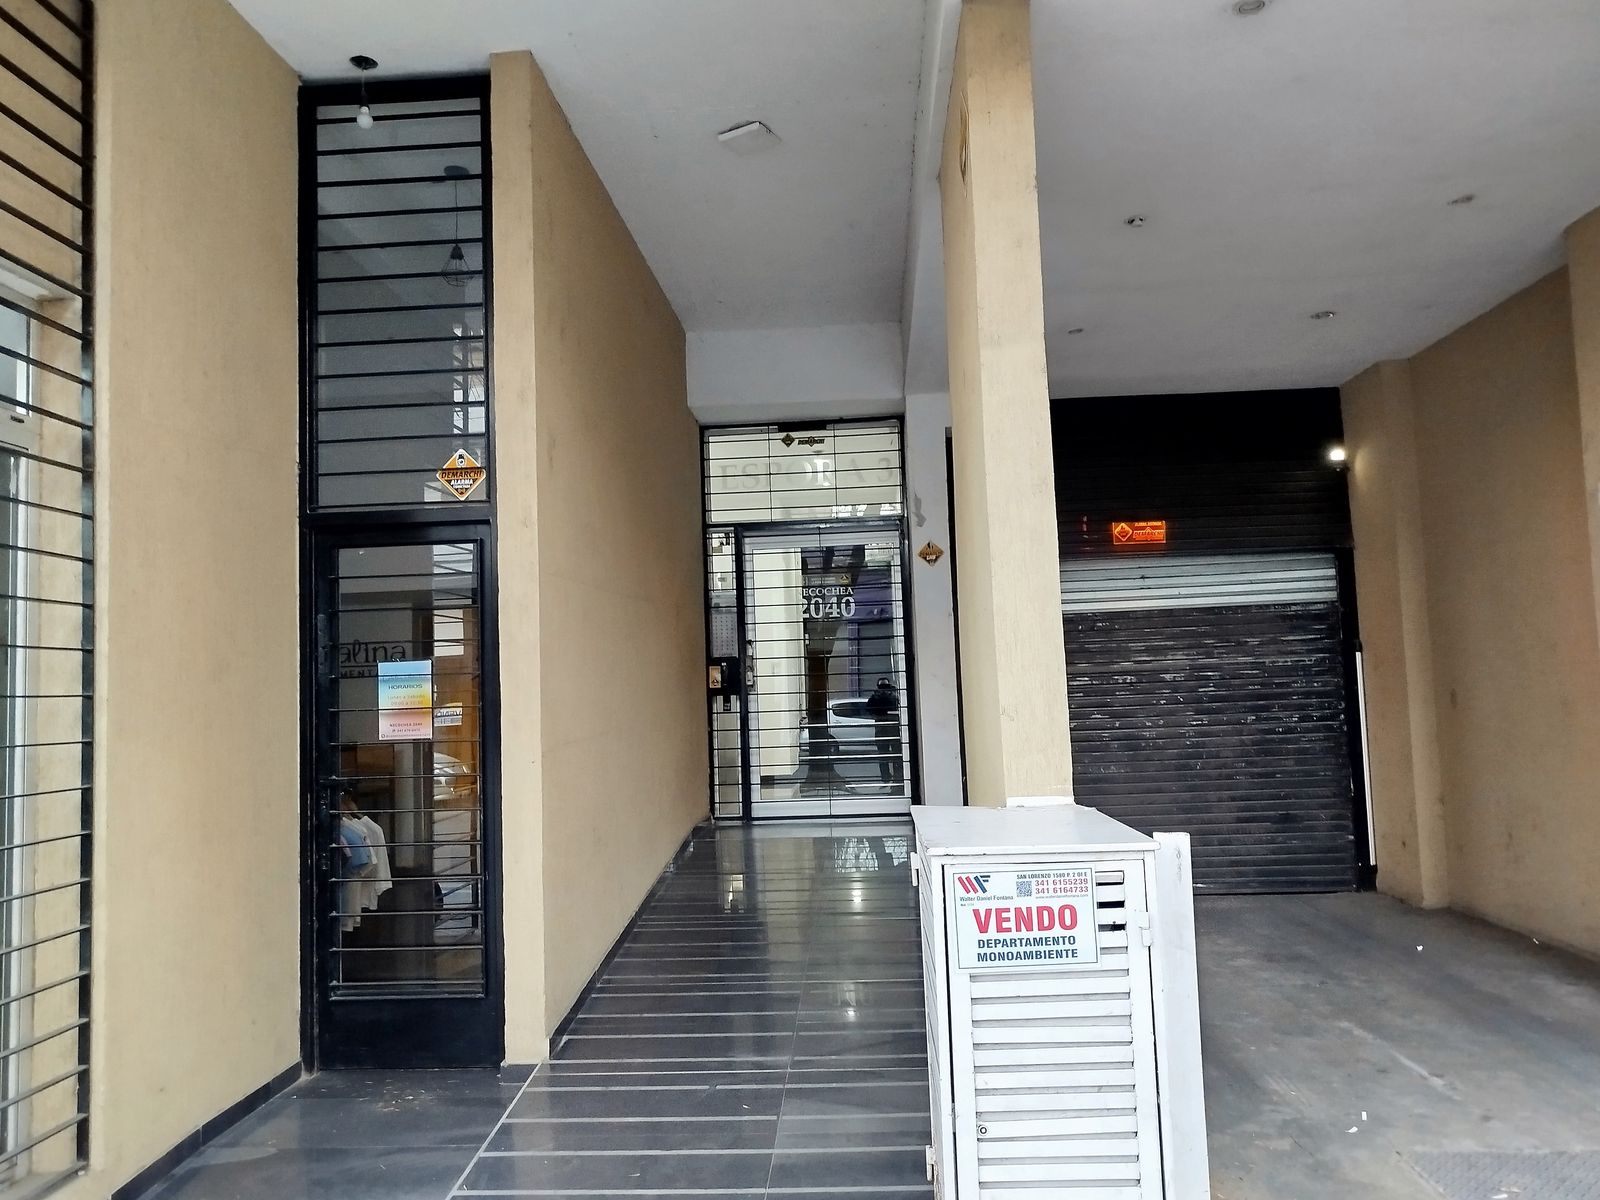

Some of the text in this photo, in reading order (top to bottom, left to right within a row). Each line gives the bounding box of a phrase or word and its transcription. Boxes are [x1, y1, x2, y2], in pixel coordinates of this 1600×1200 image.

[441, 470, 482, 478] DEMARCHI
[801, 587, 854, 597] ECOCHEA
[800, 596, 856, 619] 2040
[1028, 872, 1051, 880] LORENZO
[1034, 879, 1050, 887] 341
[1052, 886, 1089, 894] 6164733
[973, 905, 1078, 933] VENDO
[977, 935, 1076, 949] DEPARTAMENTO
[977, 948, 1078, 962] MONOAMBIENTE
